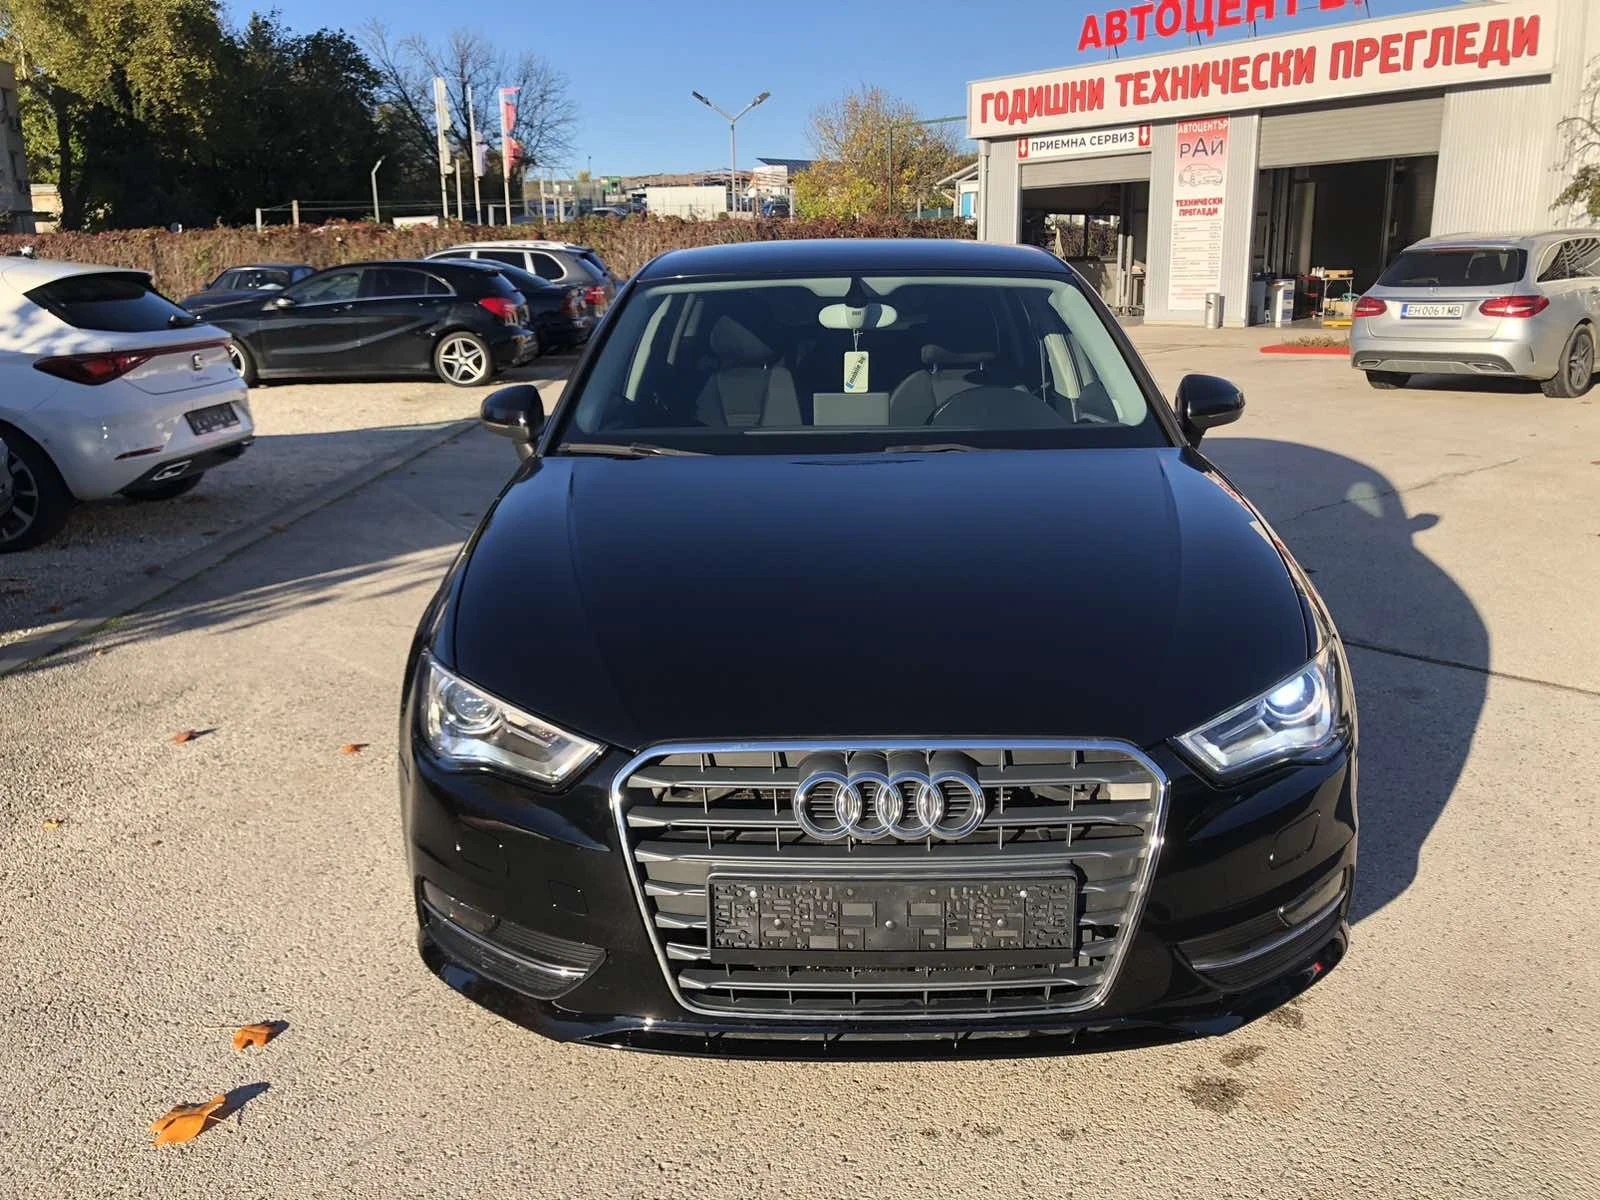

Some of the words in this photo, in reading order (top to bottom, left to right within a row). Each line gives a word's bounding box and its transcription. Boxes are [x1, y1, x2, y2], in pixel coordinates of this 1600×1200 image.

[1077, 0, 1363, 52] АВТОЦЕН
[981, 77, 1105, 125] ГОДИШНИ
[1115, 46, 1316, 107] ТЕХНИЧЕСКИ
[1329, 15, 1540, 80] ПРЕГЛЕДИ
[1178, 120, 1228, 134] АВТОЦЕНТЪР
[1031, 137, 1087, 152] ПРИЕМНА
[1089, 131, 1135, 146] СЕРВИЗ
[1180, 136, 1223, 158] РАЙ
[1176, 197, 1223, 207] ТЕХНИЧЕСКИ
[1179, 207, 1218, 216] ПРЕГЛЕДИ
